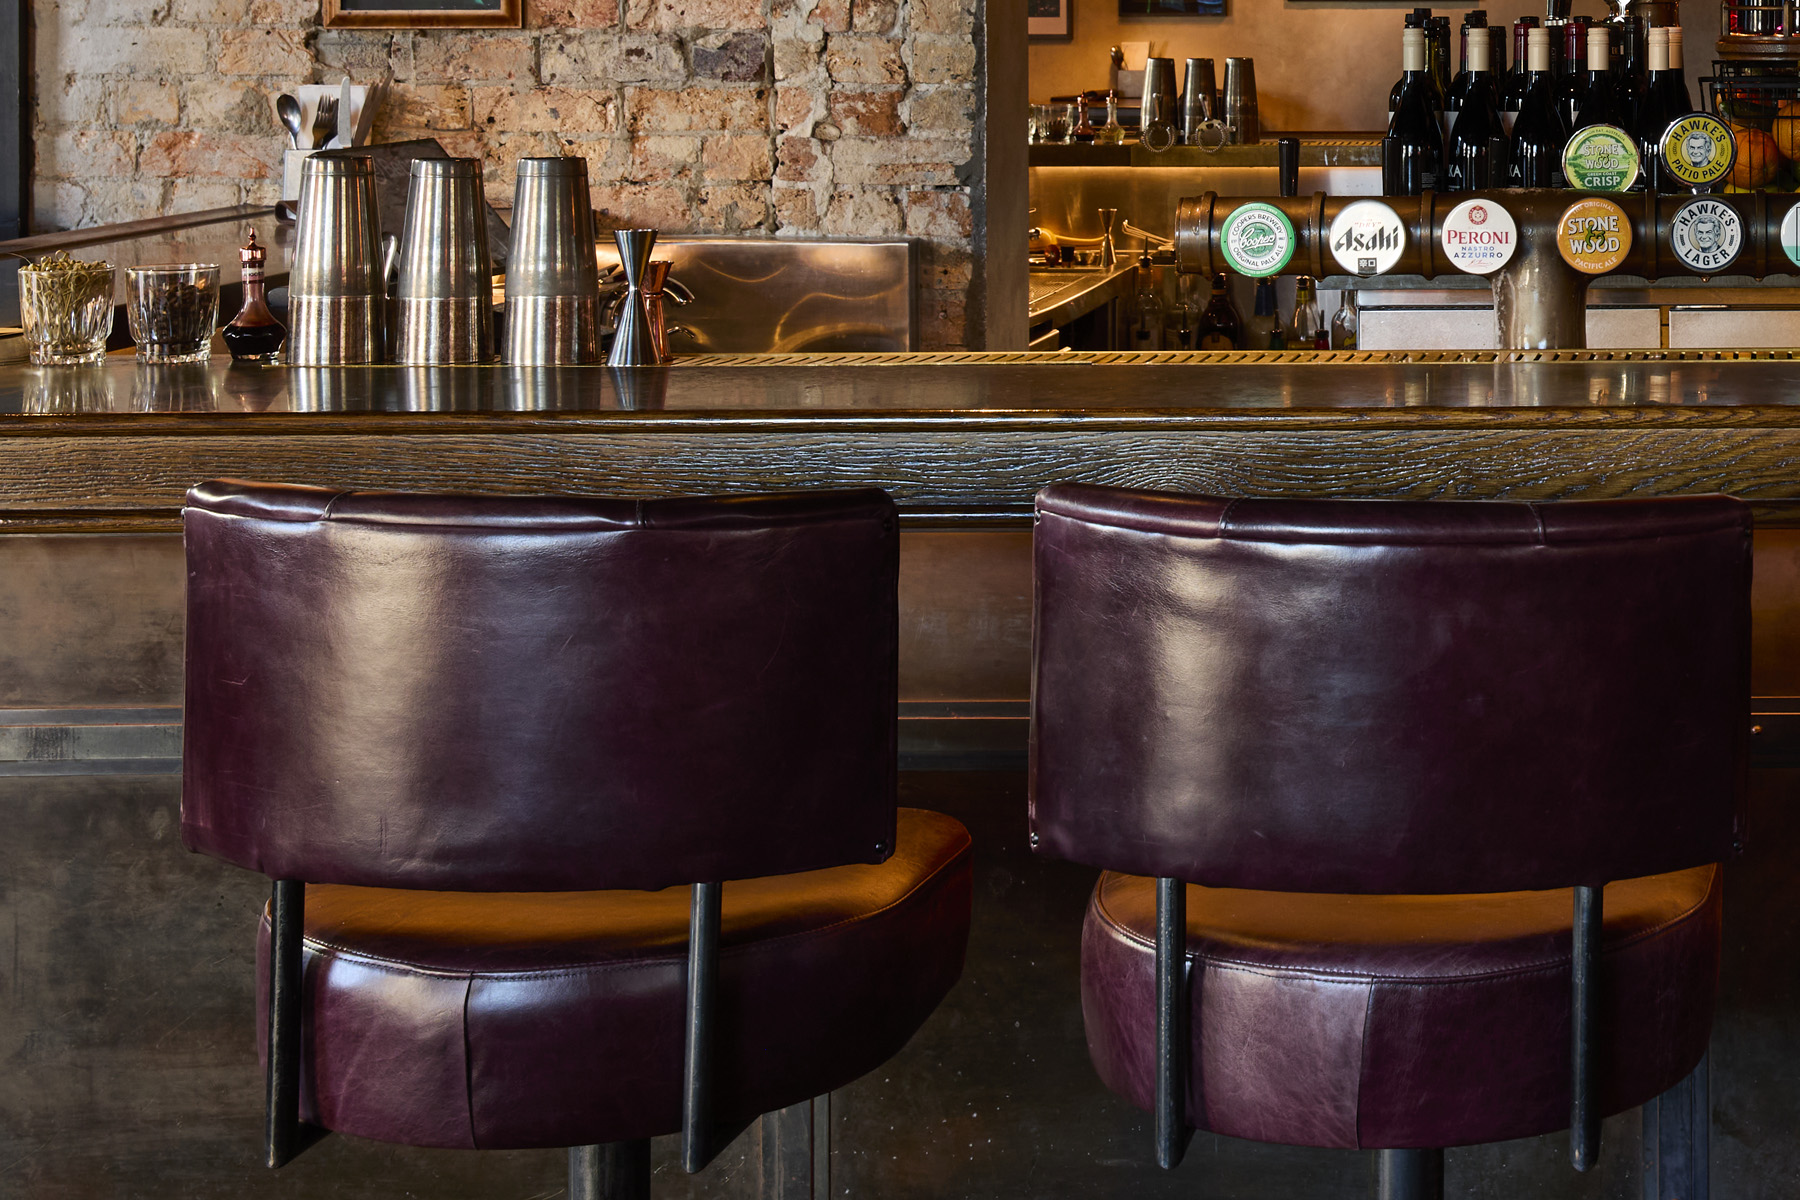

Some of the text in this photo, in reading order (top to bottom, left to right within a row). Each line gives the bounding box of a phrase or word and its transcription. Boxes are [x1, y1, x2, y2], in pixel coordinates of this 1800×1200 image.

[1672, 119, 1726, 143] HAWKE'S
[1583, 144, 1619, 156] STONE
[1585, 158, 1619, 169] WOOD
[1672, 158, 1724, 180] PATIO PALE
[1584, 176, 1621, 187] CRISP
[1584, 202, 1614, 212] ORIGINAL
[1679, 203, 1735, 227] HAWKE'S
[1232, 214, 1283, 236] COOPERS BREWERY
[1567, 215, 1620, 235] STONE
[1334, 225, 1399, 252] Asahi
[1447, 230, 1510, 244] PERONI
[1570, 238, 1621, 254] WOOD
[1233, 246, 1283, 266] ORIGINAL PALE ALE
[1575, 256, 1617, 269] PACIFIC ALE
[1684, 249, 1730, 266] LAGER
